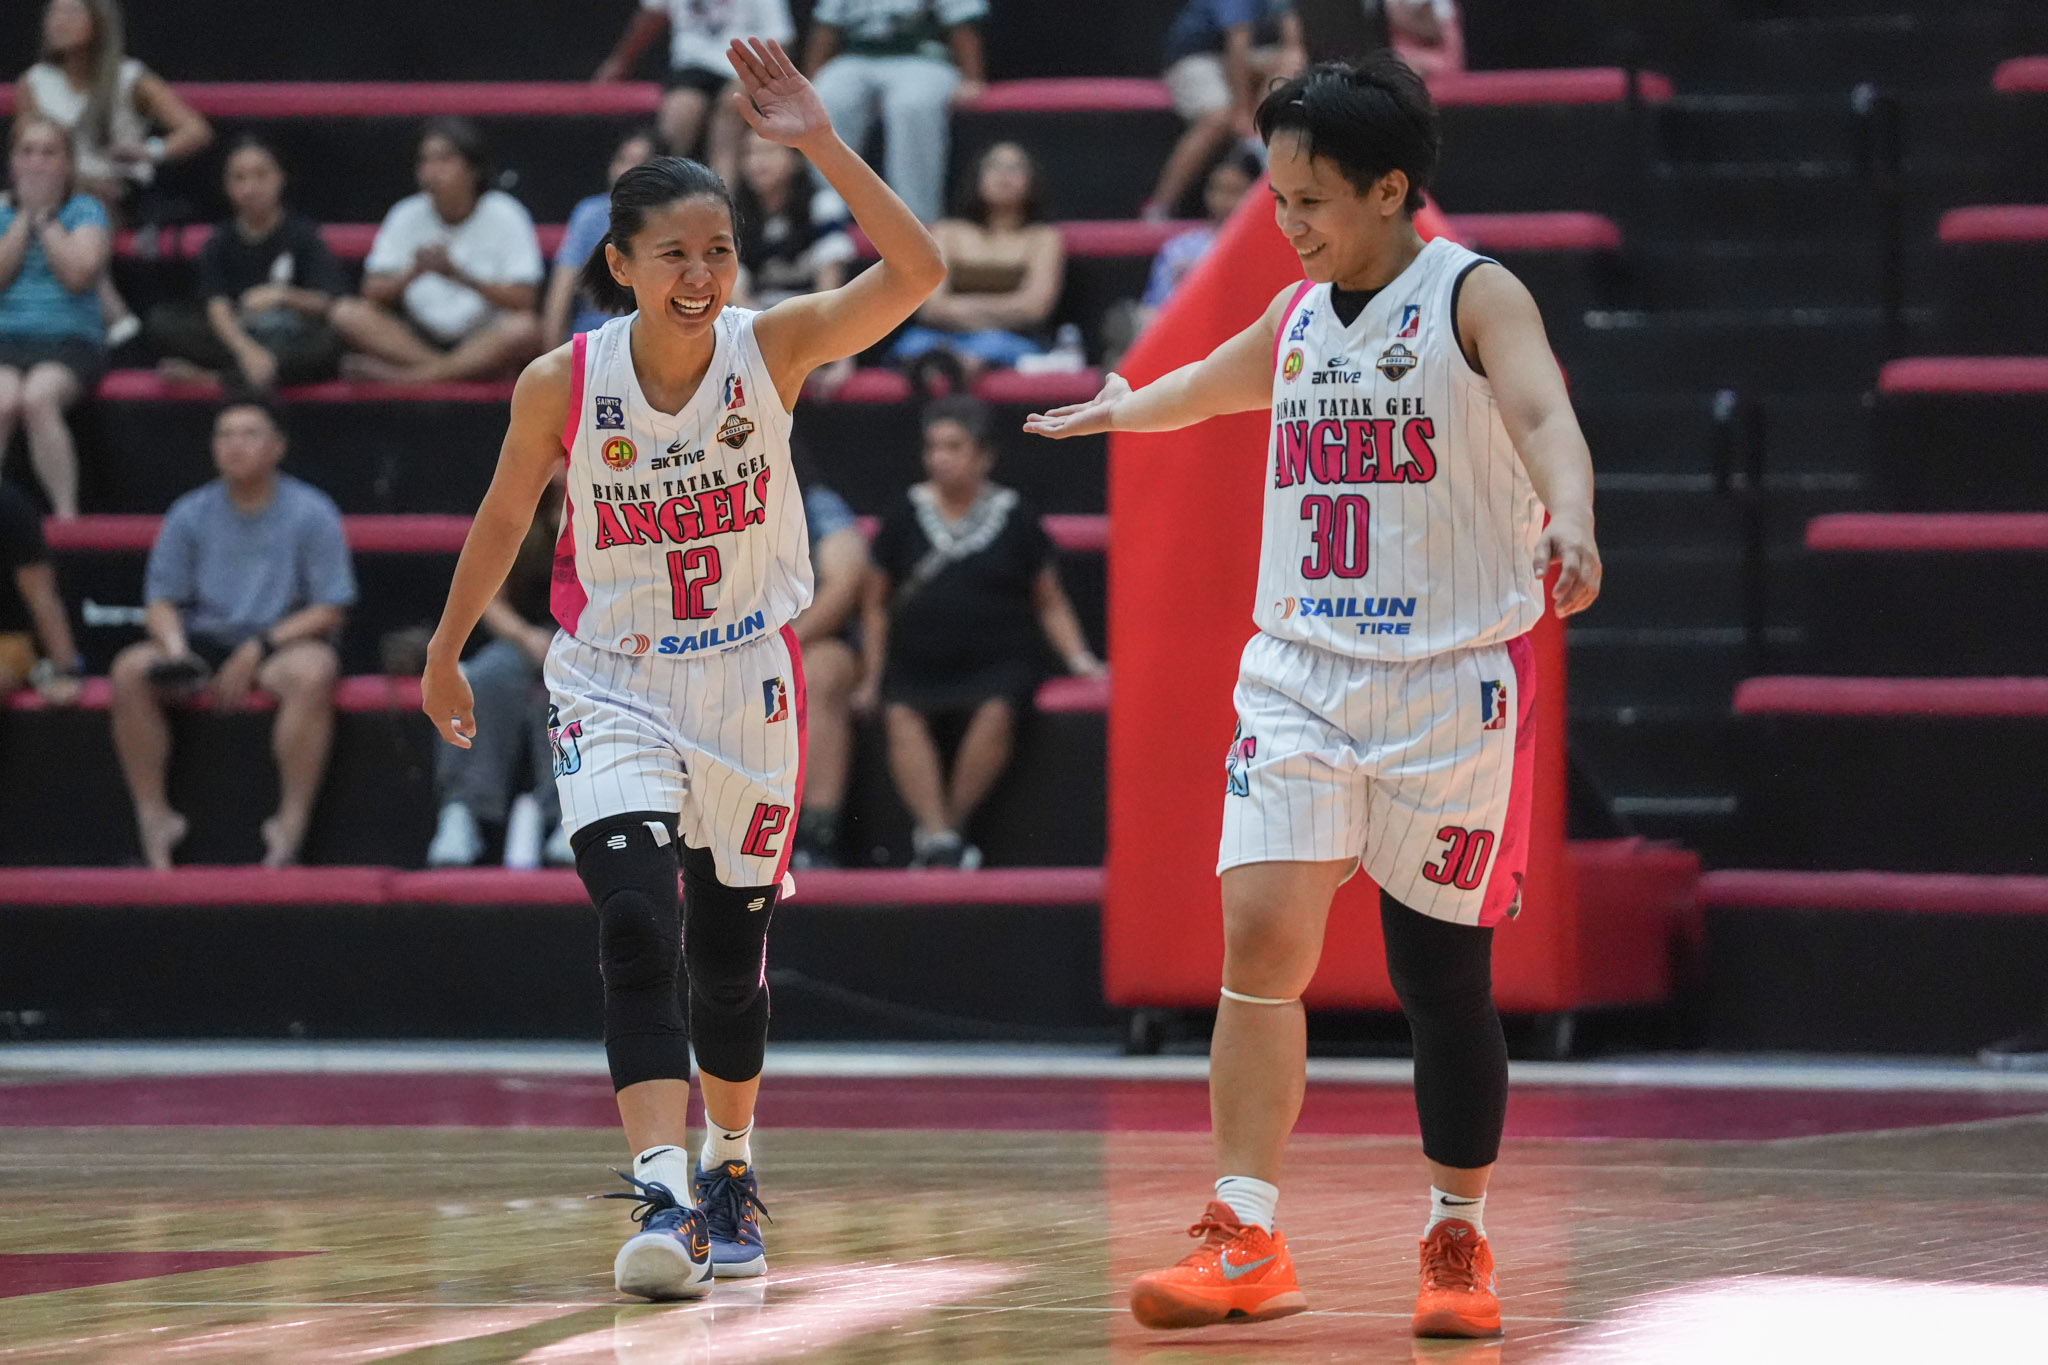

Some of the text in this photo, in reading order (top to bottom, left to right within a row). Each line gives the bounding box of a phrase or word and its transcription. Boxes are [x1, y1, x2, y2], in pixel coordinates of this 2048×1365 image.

[596, 397, 620, 406] SAINTS
[1318, 398, 1373, 416] TATAK
[1386, 397, 1426, 416] GEL
[592, 453, 767, 501] BIÑAN TATAK GEL
[1275, 417, 1437, 489] ANGELS
[1300, 494, 1370, 579] 30
[666, 545, 722, 620] 12
[1299, 597, 1417, 618] SAILUN
[1355, 622, 1412, 635] TIRE
[658, 610, 765, 654] SAILUN
[741, 802, 790, 857] 12
[1422, 825, 1495, 890] 30
